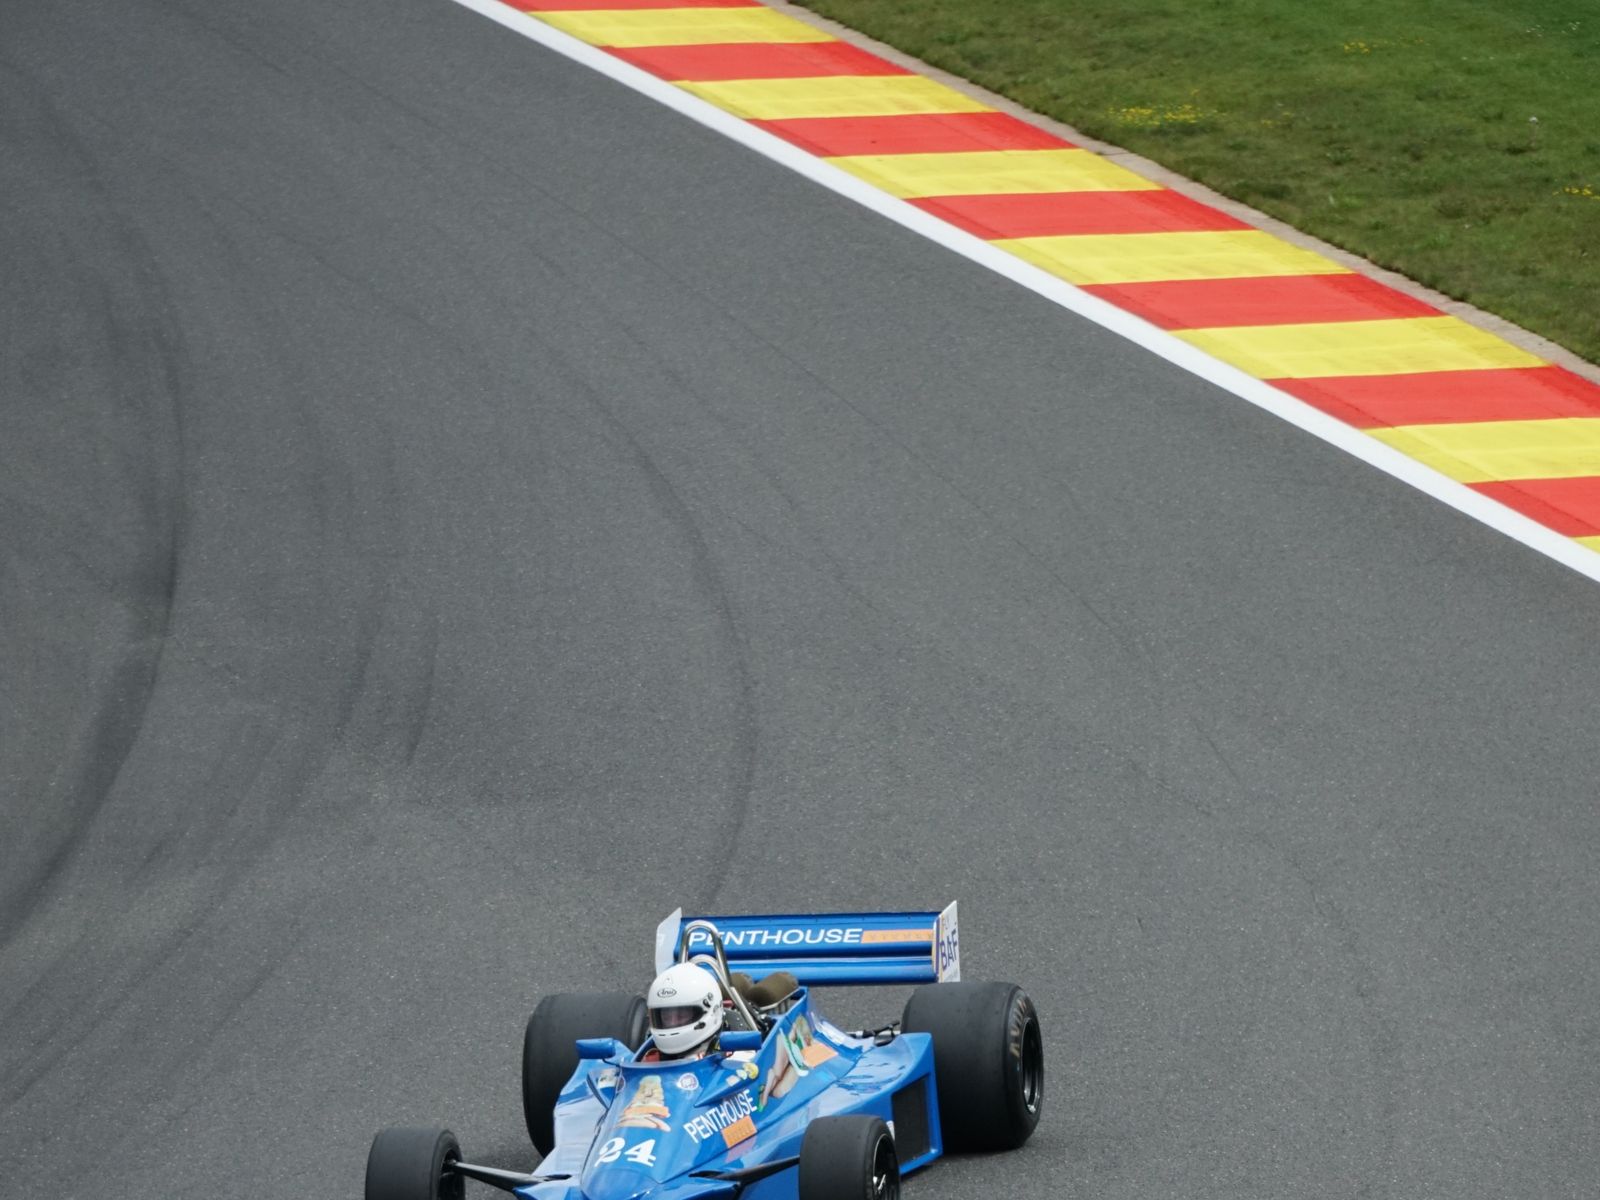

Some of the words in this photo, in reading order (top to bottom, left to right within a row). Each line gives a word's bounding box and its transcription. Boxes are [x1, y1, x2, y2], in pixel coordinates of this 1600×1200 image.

[688, 928, 862, 946] PENTHOUSE
[940, 928, 957, 971] BAF
[683, 1089, 757, 1144] PENTHOUSE
[594, 1137, 656, 1167] 24
